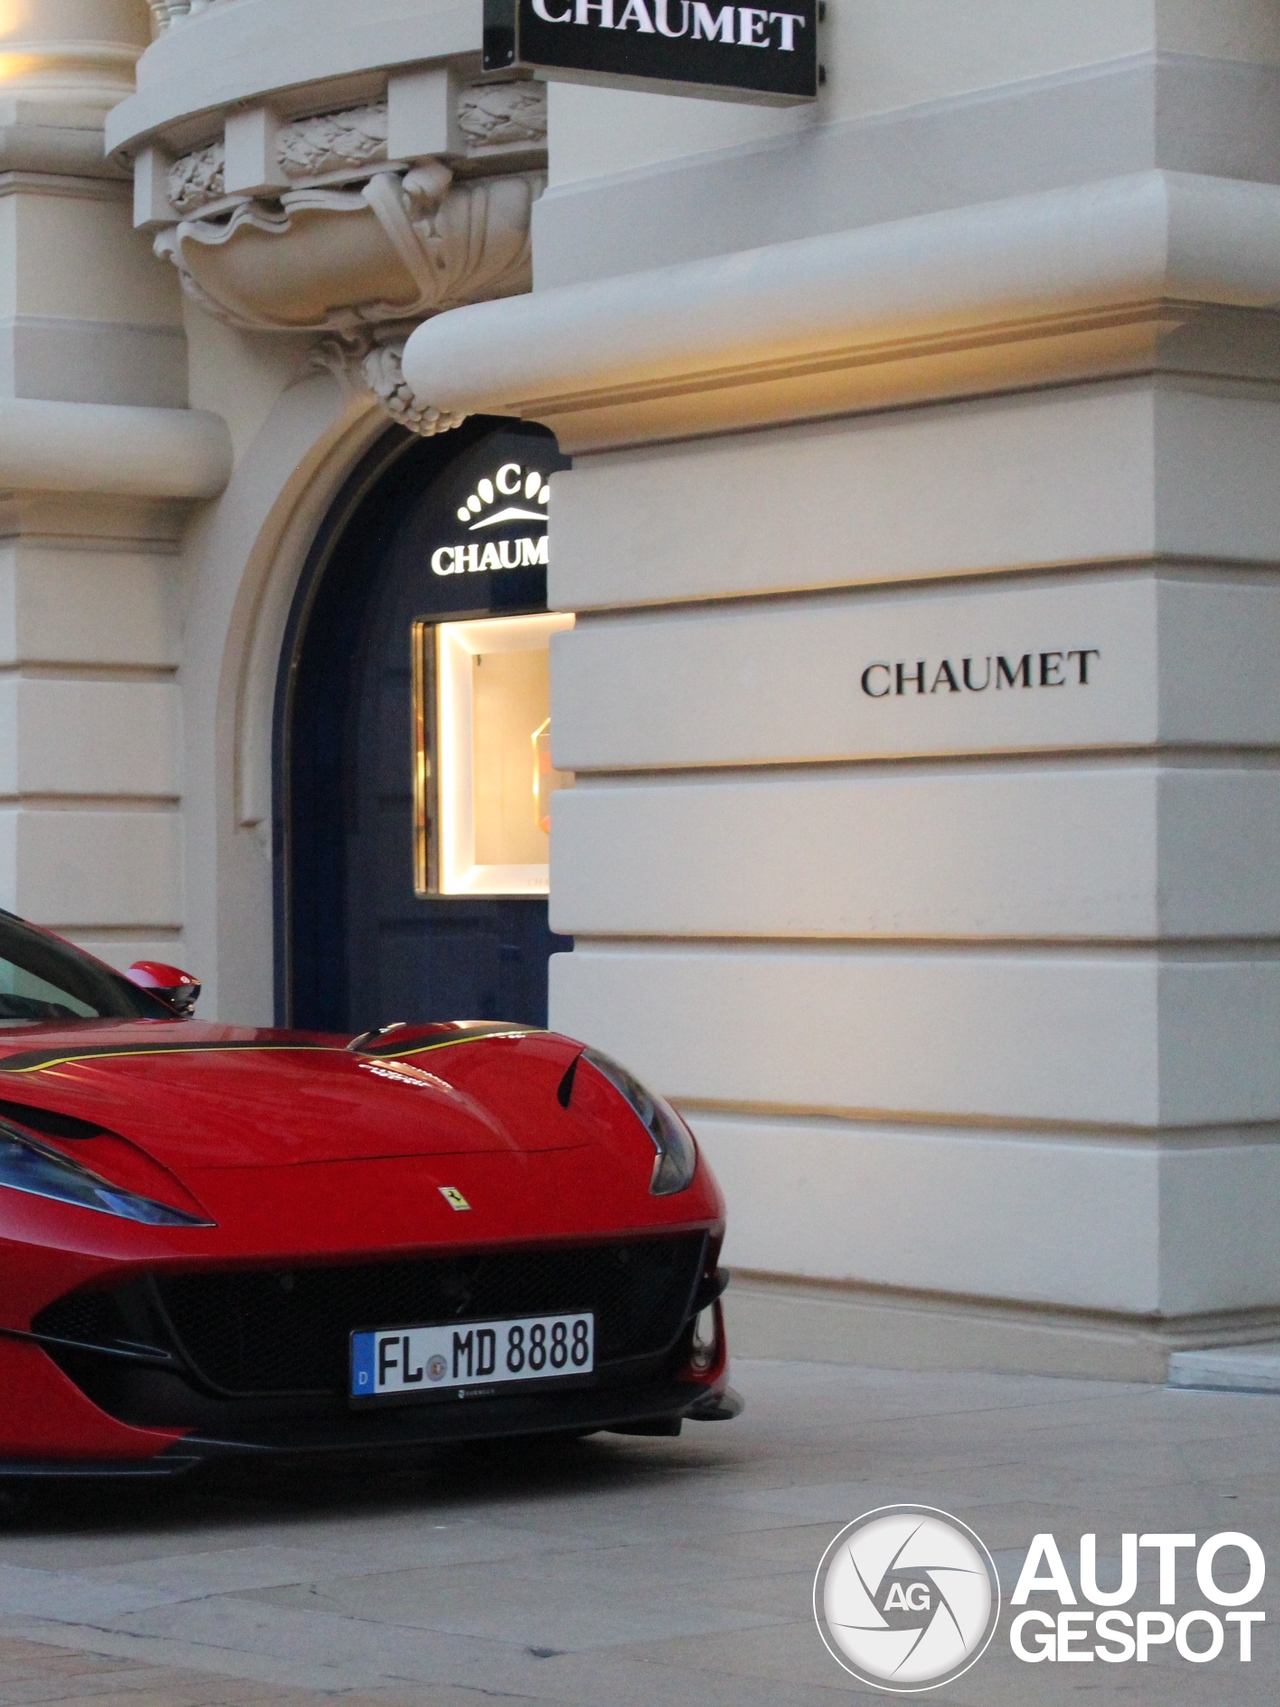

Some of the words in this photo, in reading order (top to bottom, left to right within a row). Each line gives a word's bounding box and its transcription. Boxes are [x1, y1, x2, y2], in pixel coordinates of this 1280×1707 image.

[531, 0, 806, 51] CHAUMET
[860, 649, 1101, 698] CHAUMET
[378, 1336, 424, 1386] FL
[452, 1329, 496, 1378] MD
[506, 1319, 589, 1373] 8888
[358, 1371, 369, 1386] D
